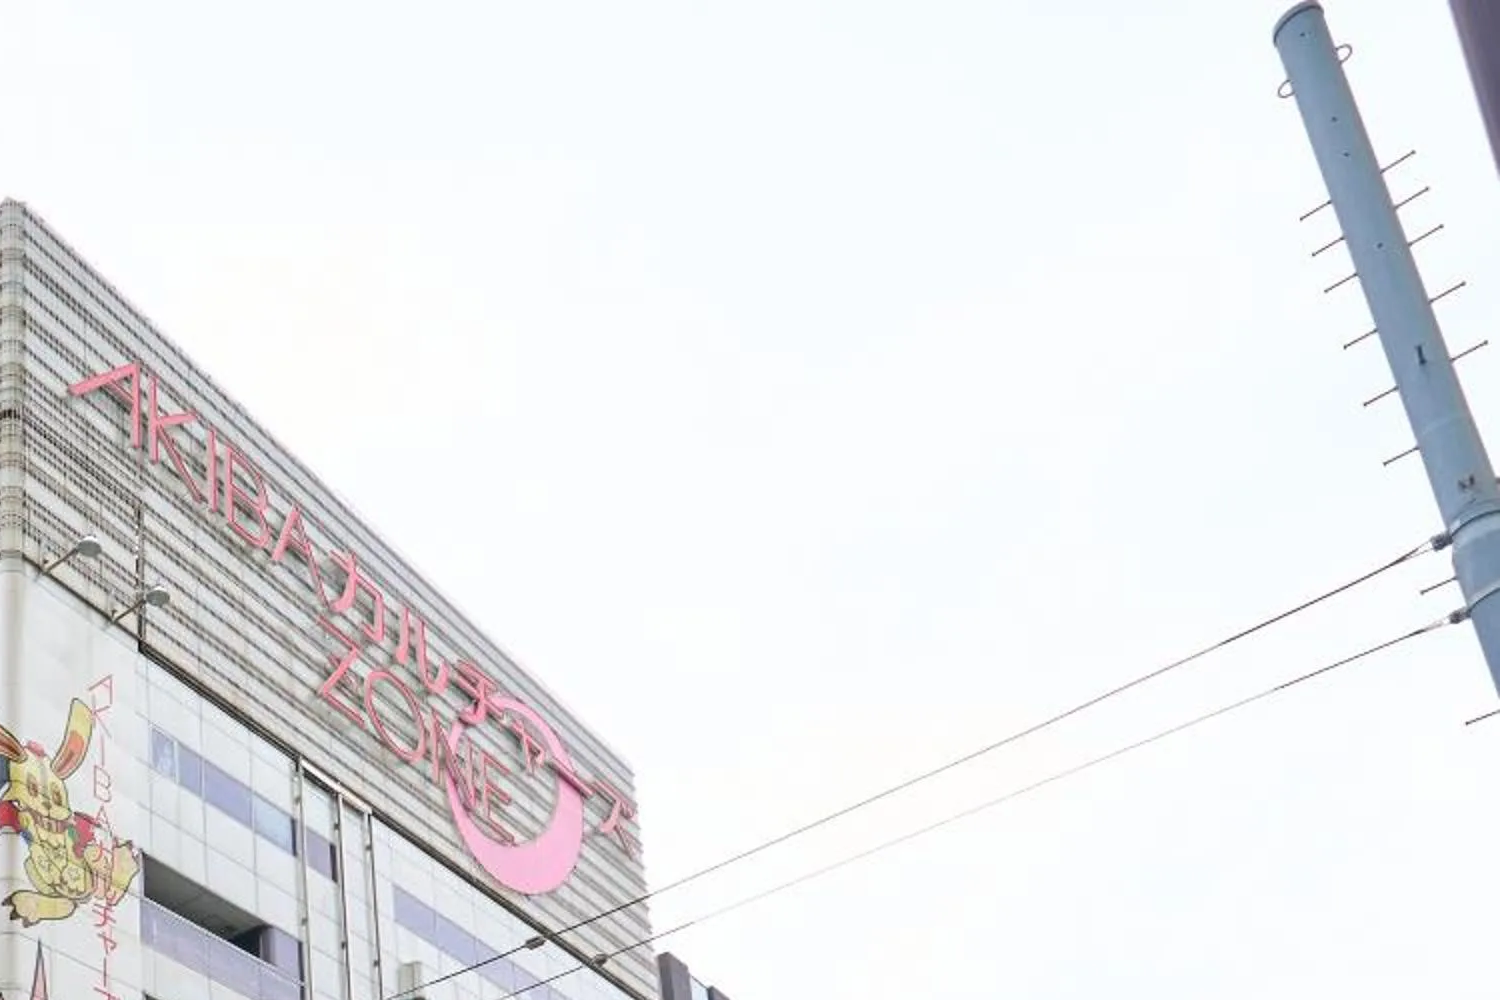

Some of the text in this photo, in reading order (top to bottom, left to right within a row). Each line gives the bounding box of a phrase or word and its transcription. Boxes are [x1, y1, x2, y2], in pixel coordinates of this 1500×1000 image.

[67, 361, 332, 608] AKIBA
[88, 675, 114, 842] AKIBA
[315, 614, 515, 847] ZONE
